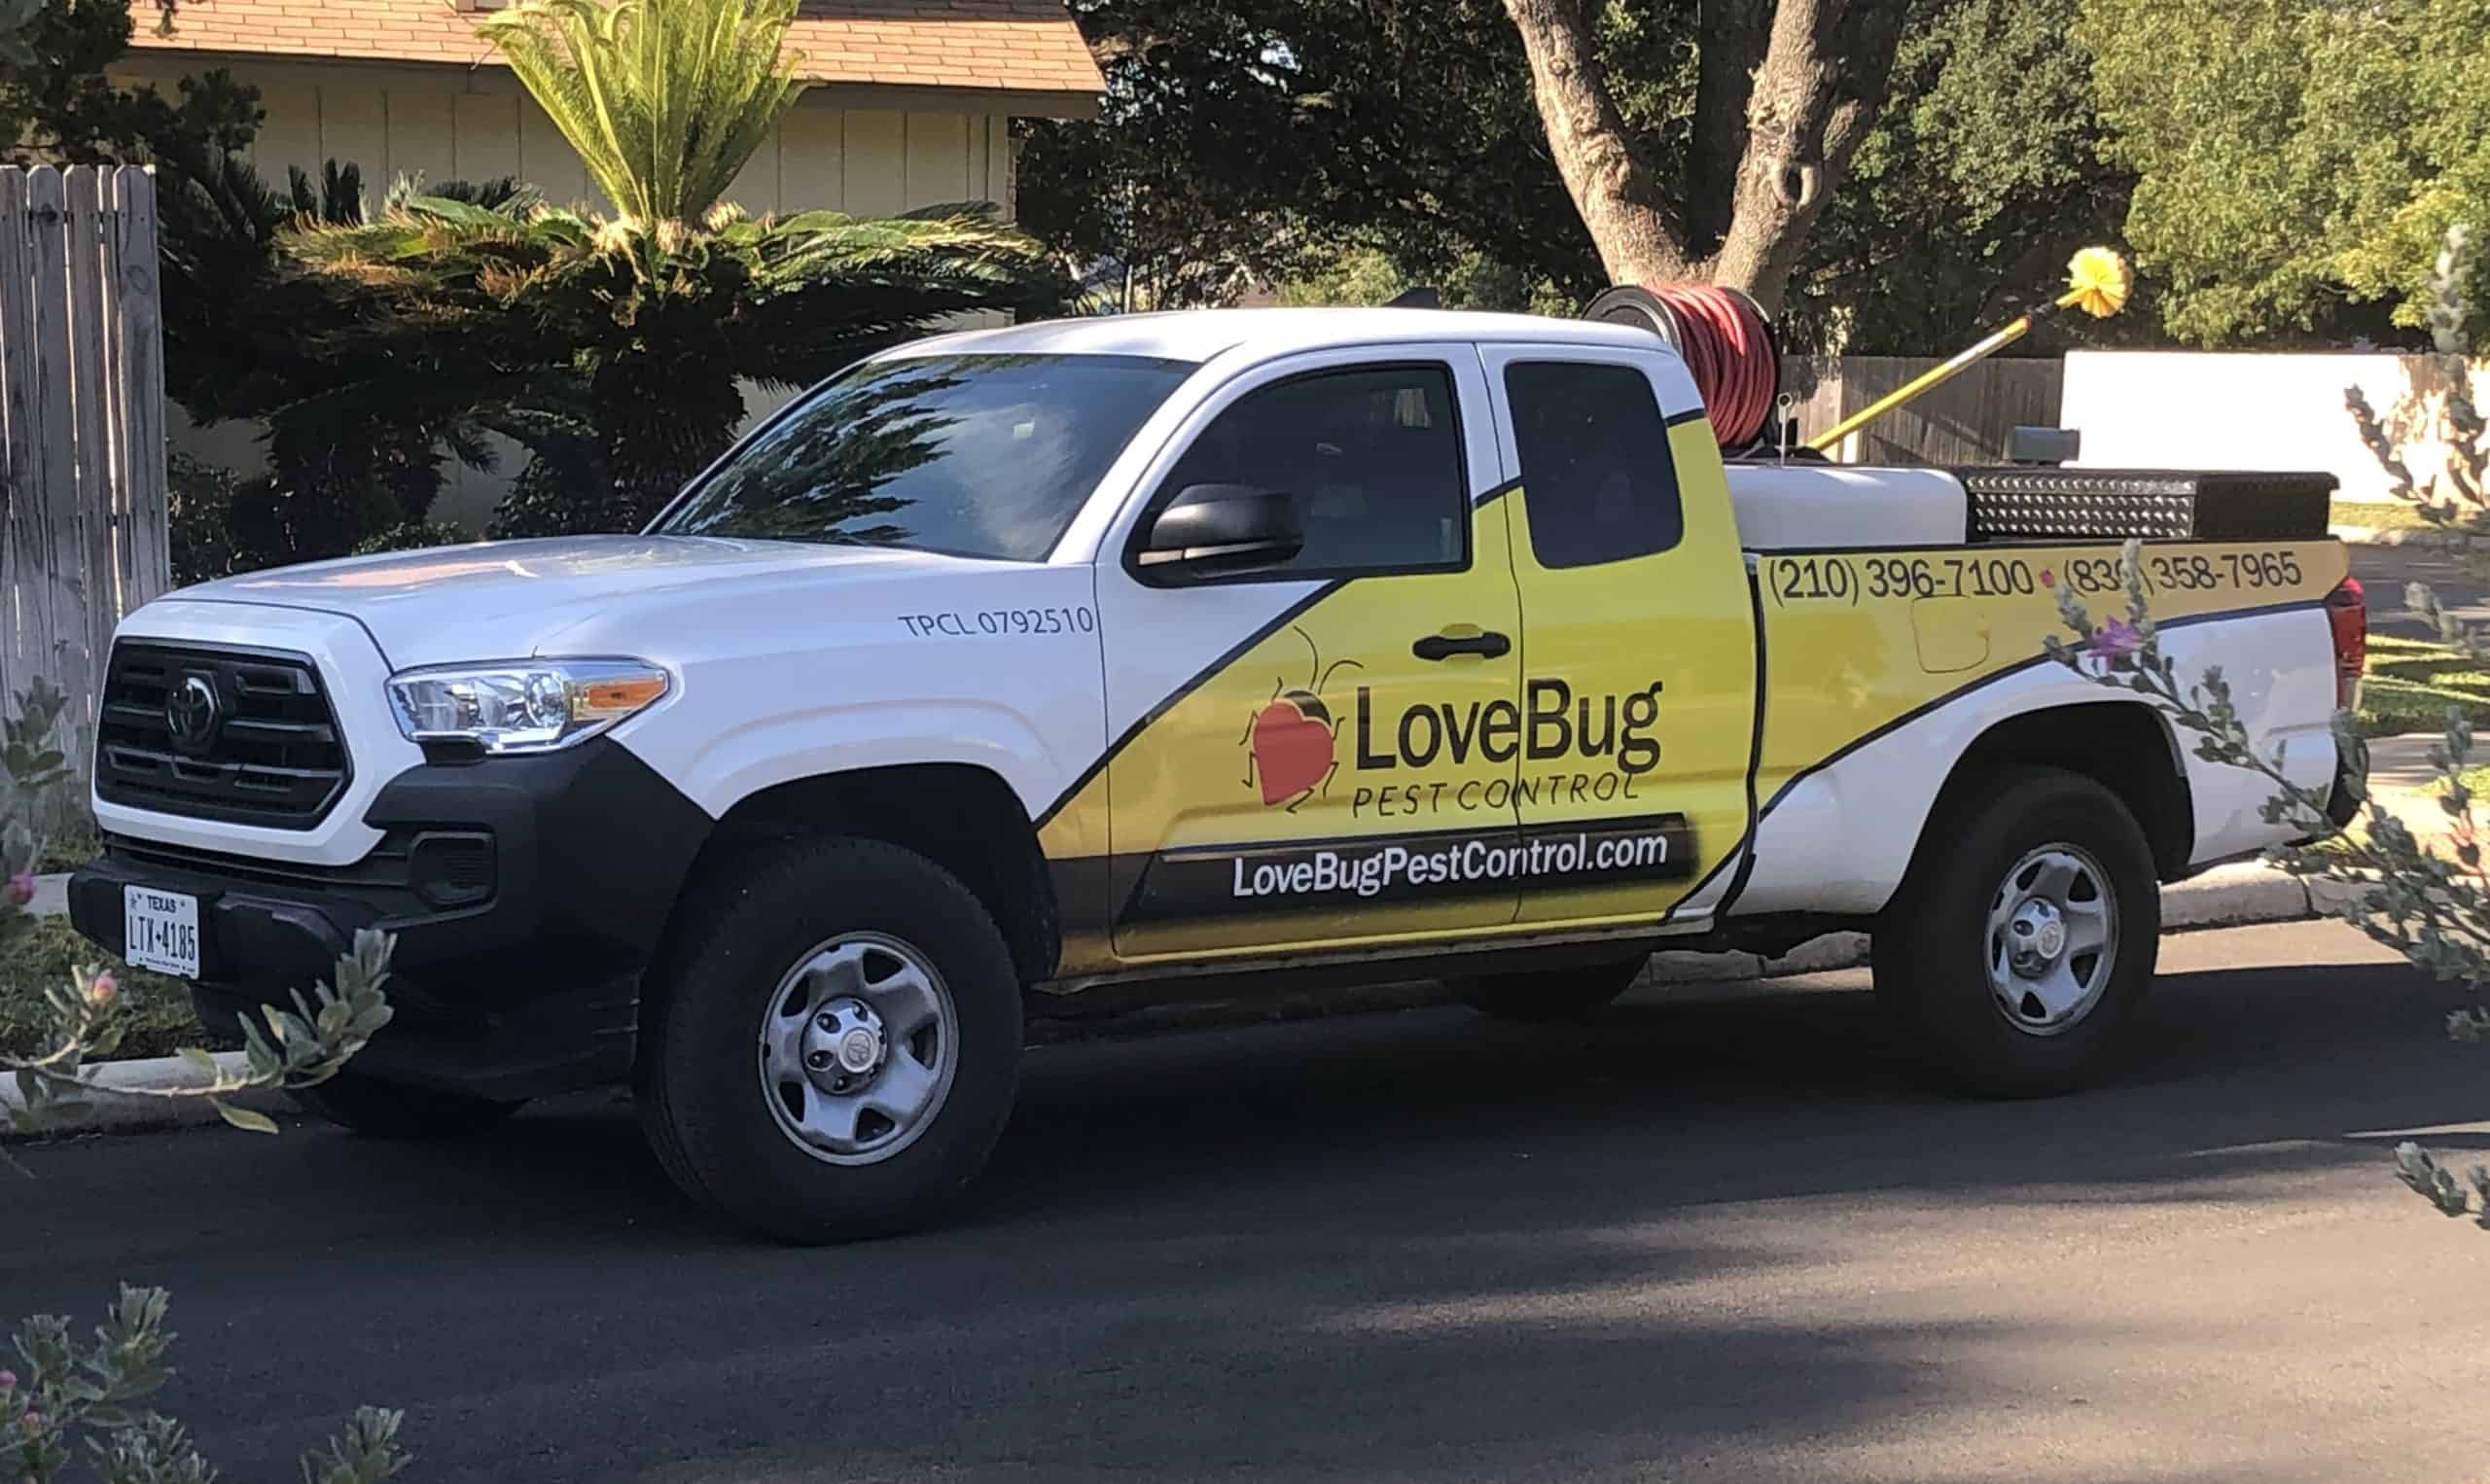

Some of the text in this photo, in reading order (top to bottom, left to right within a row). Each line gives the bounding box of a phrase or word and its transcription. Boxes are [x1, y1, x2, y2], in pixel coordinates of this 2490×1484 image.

[1768, 557, 1859, 607] (210)
[1867, 558, 2034, 599] 396-7100
[2151, 550, 2303, 590] 358-7965
[897, 606, 1093, 637] TPCL 0792510
[1356, 677, 1664, 774] LoveBug
[1352, 771, 1639, 818] PEST CONTROL
[1232, 832, 1668, 897] LoveBugPestControl.com
[147, 894, 177, 914] TEXAS
